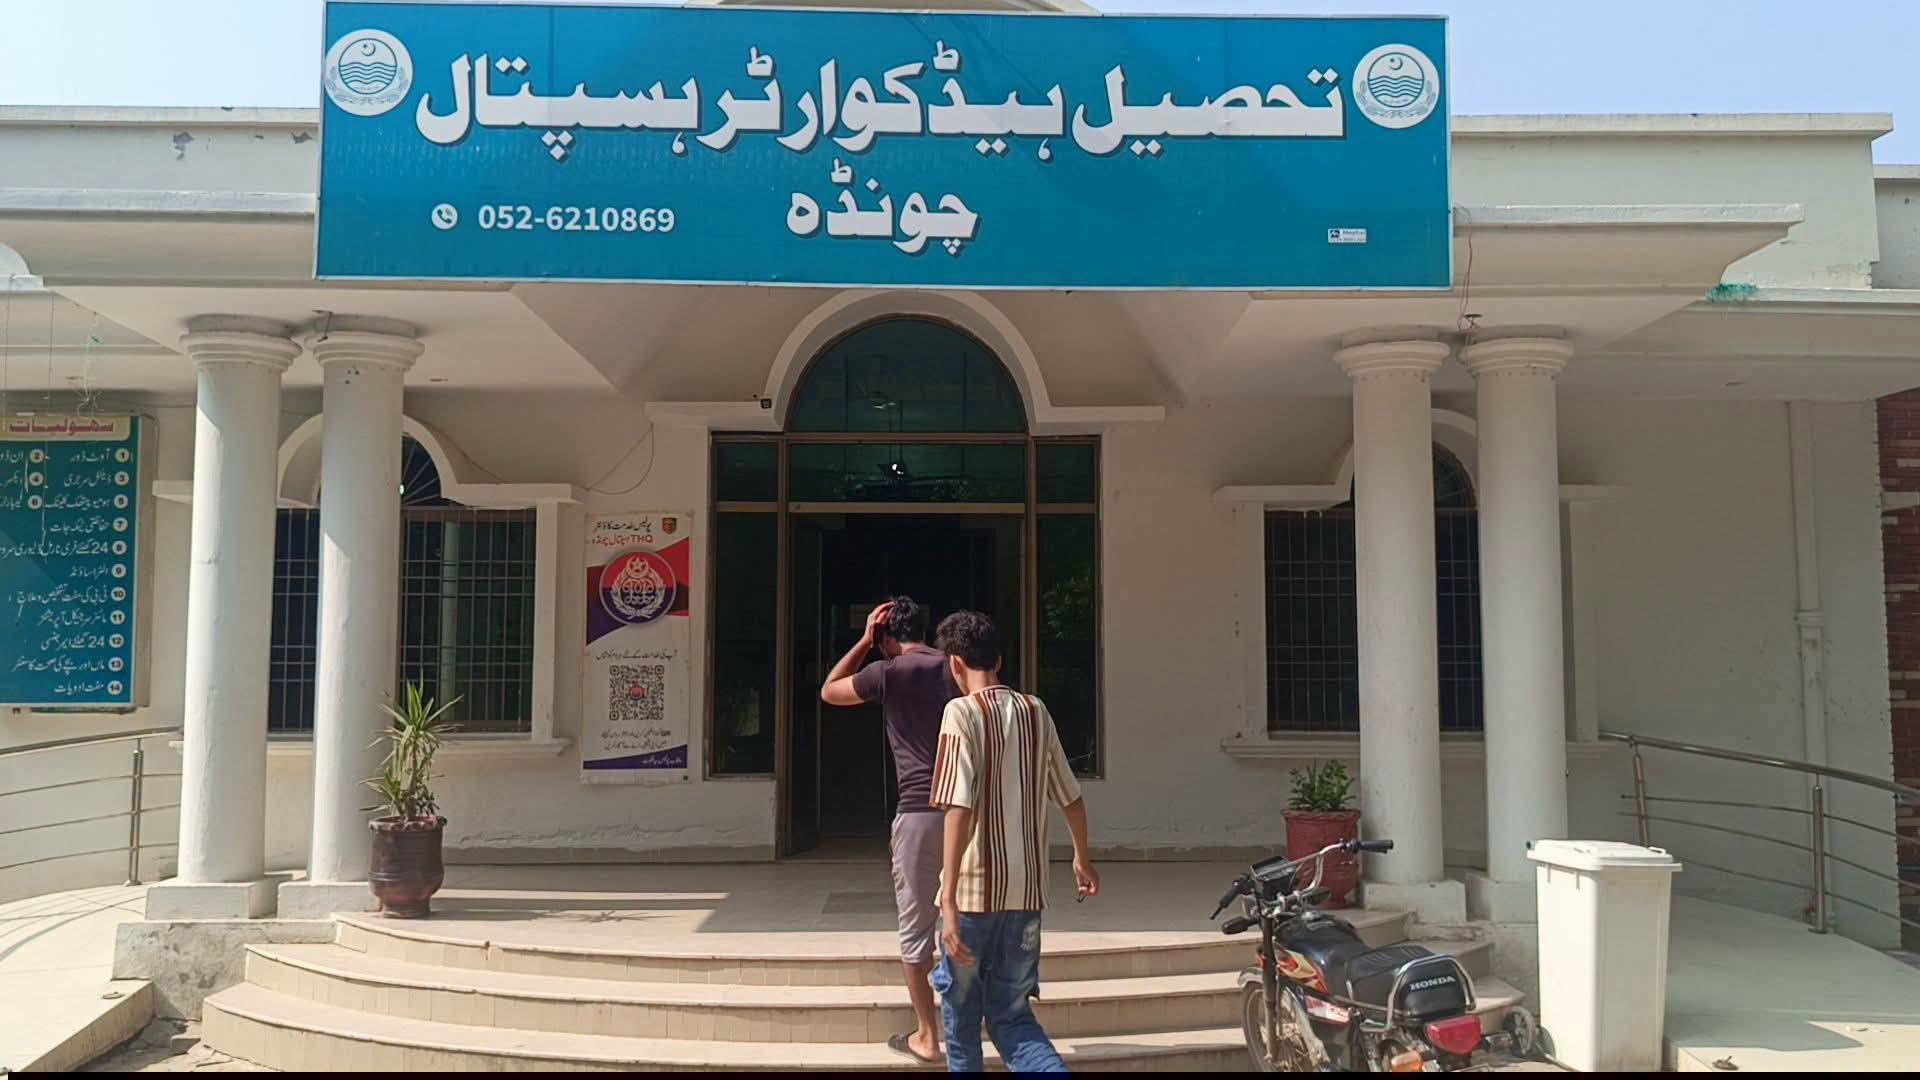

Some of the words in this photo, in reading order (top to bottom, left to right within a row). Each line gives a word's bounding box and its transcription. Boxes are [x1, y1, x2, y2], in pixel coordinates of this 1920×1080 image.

[415, 53, 699, 161] ہسپتال
[1072, 65, 1345, 157] تحصیل
[478, 204, 675, 232] 052-6210869
[786, 158, 979, 256] چونڈہ
[630, 534, 653, 543] THQ
[1409, 976, 1456, 990] HONDA
